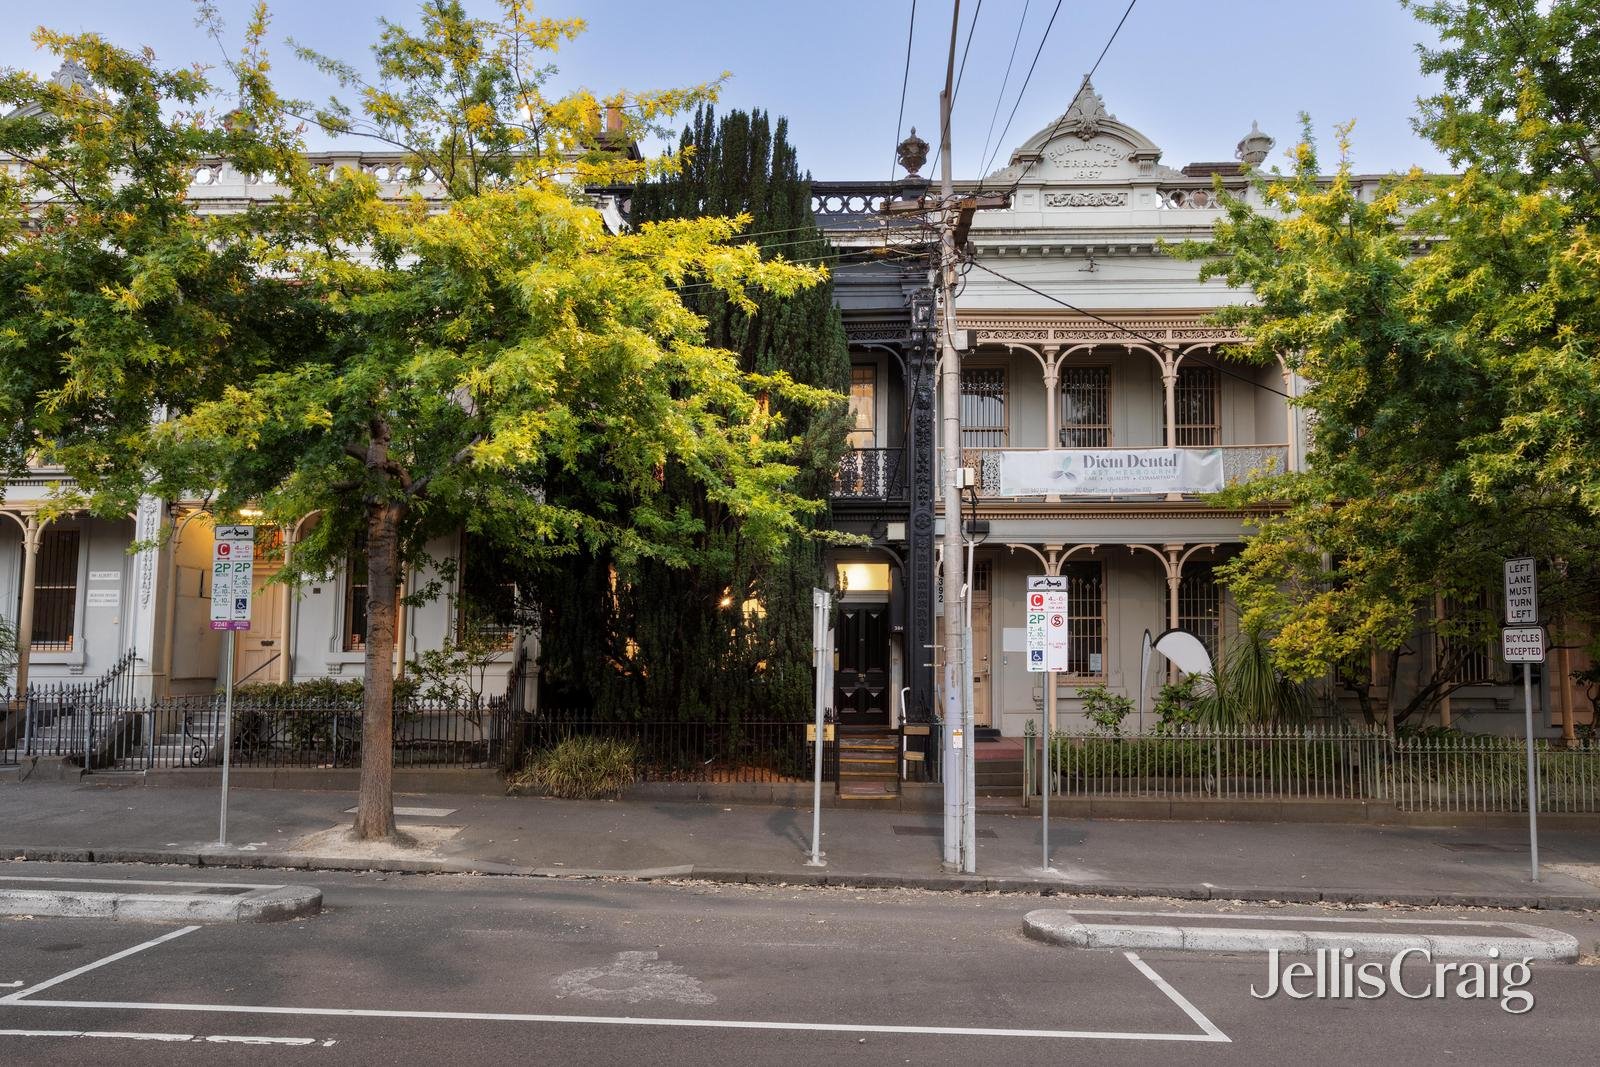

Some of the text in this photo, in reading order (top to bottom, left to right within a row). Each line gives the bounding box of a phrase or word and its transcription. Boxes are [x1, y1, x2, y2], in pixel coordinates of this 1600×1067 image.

[1048, 143, 1126, 160] BURLINGTON
[1054, 160, 1118, 168] TERRACE
[1074, 170, 1102, 179] 1867
[1083, 453, 1177, 468] Diem Dental
[214, 563, 251, 573] 2P 2P
[1509, 564, 1530, 573] LEFT
[1509, 575, 1532, 584] LANE
[1509, 587, 1532, 596] MUST
[1510, 599, 1532, 607] TURN
[1029, 614, 1045, 624] 2P
[1511, 610, 1532, 619] LEFT
[1505, 634, 1540, 643] BICYCLES
[1505, 647, 1541, 656] EXCEPTED
